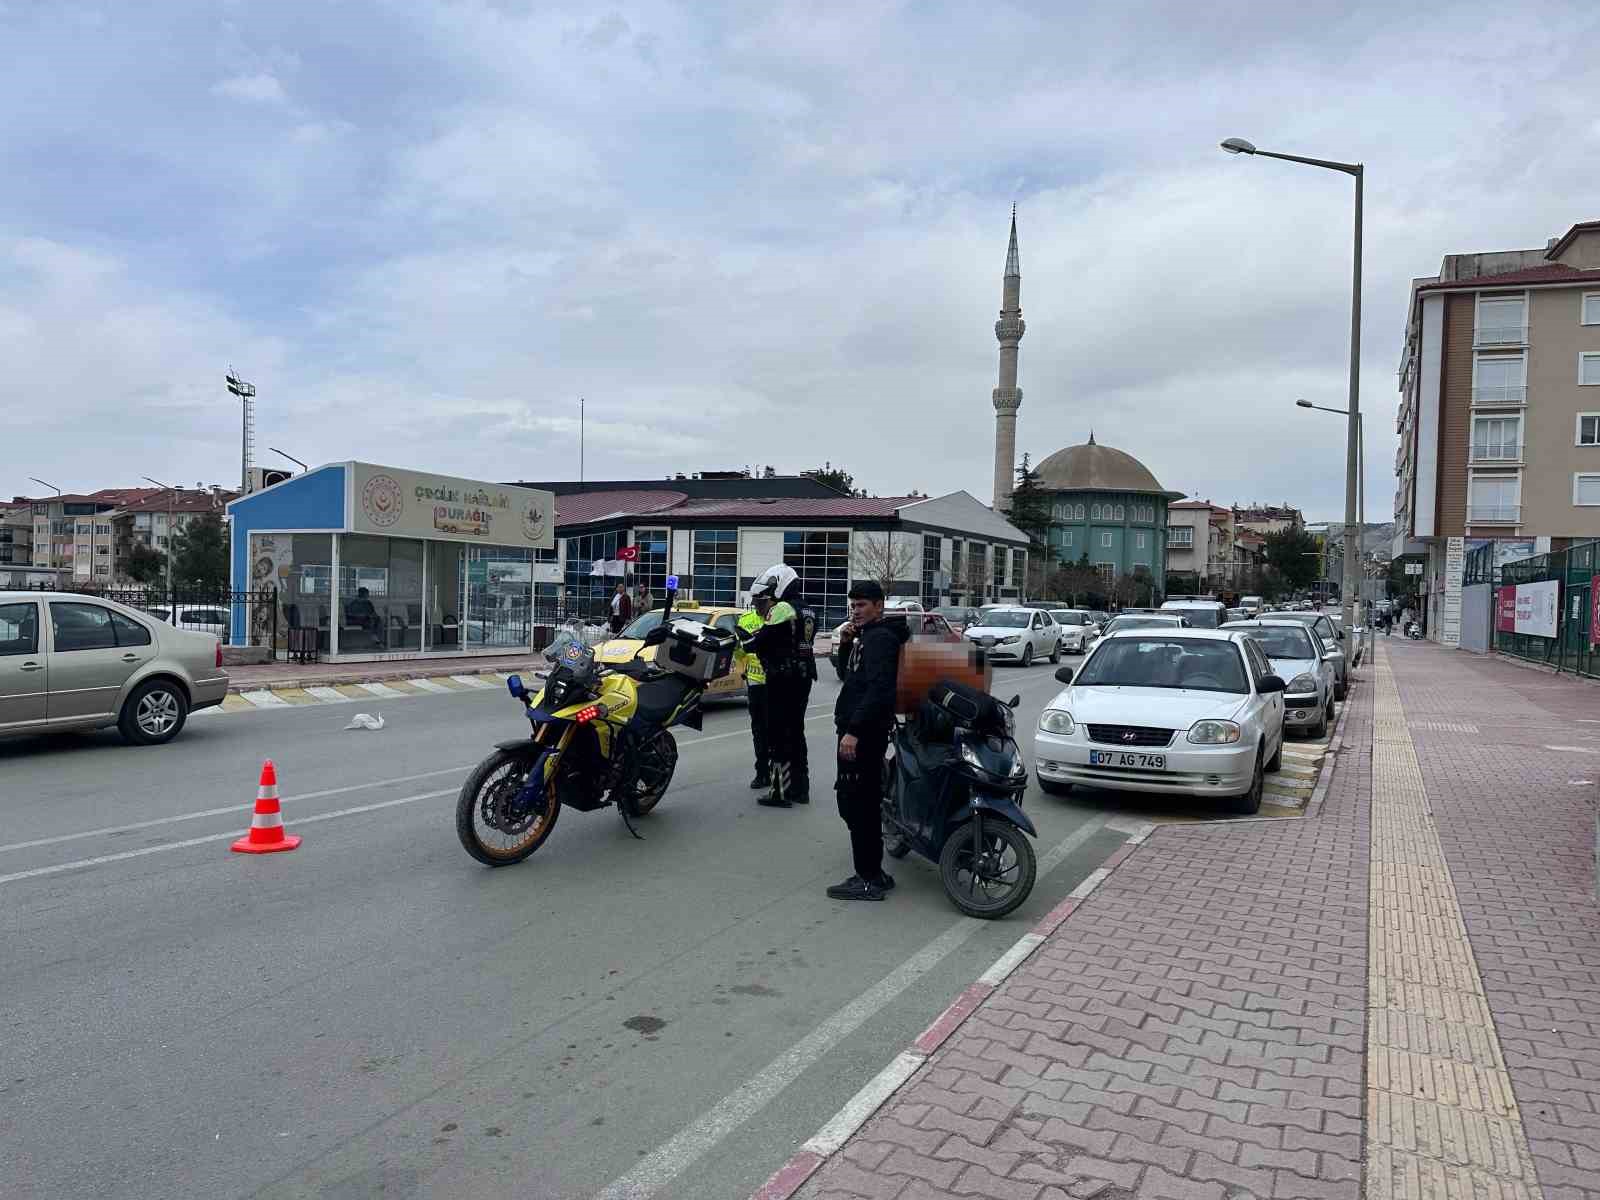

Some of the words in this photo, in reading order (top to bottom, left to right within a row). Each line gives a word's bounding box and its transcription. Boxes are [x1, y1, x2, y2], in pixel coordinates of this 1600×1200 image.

[1097, 752, 1113, 764] 07
[1119, 753, 1136, 766] AG
[1138, 755, 1164, 768] 749
